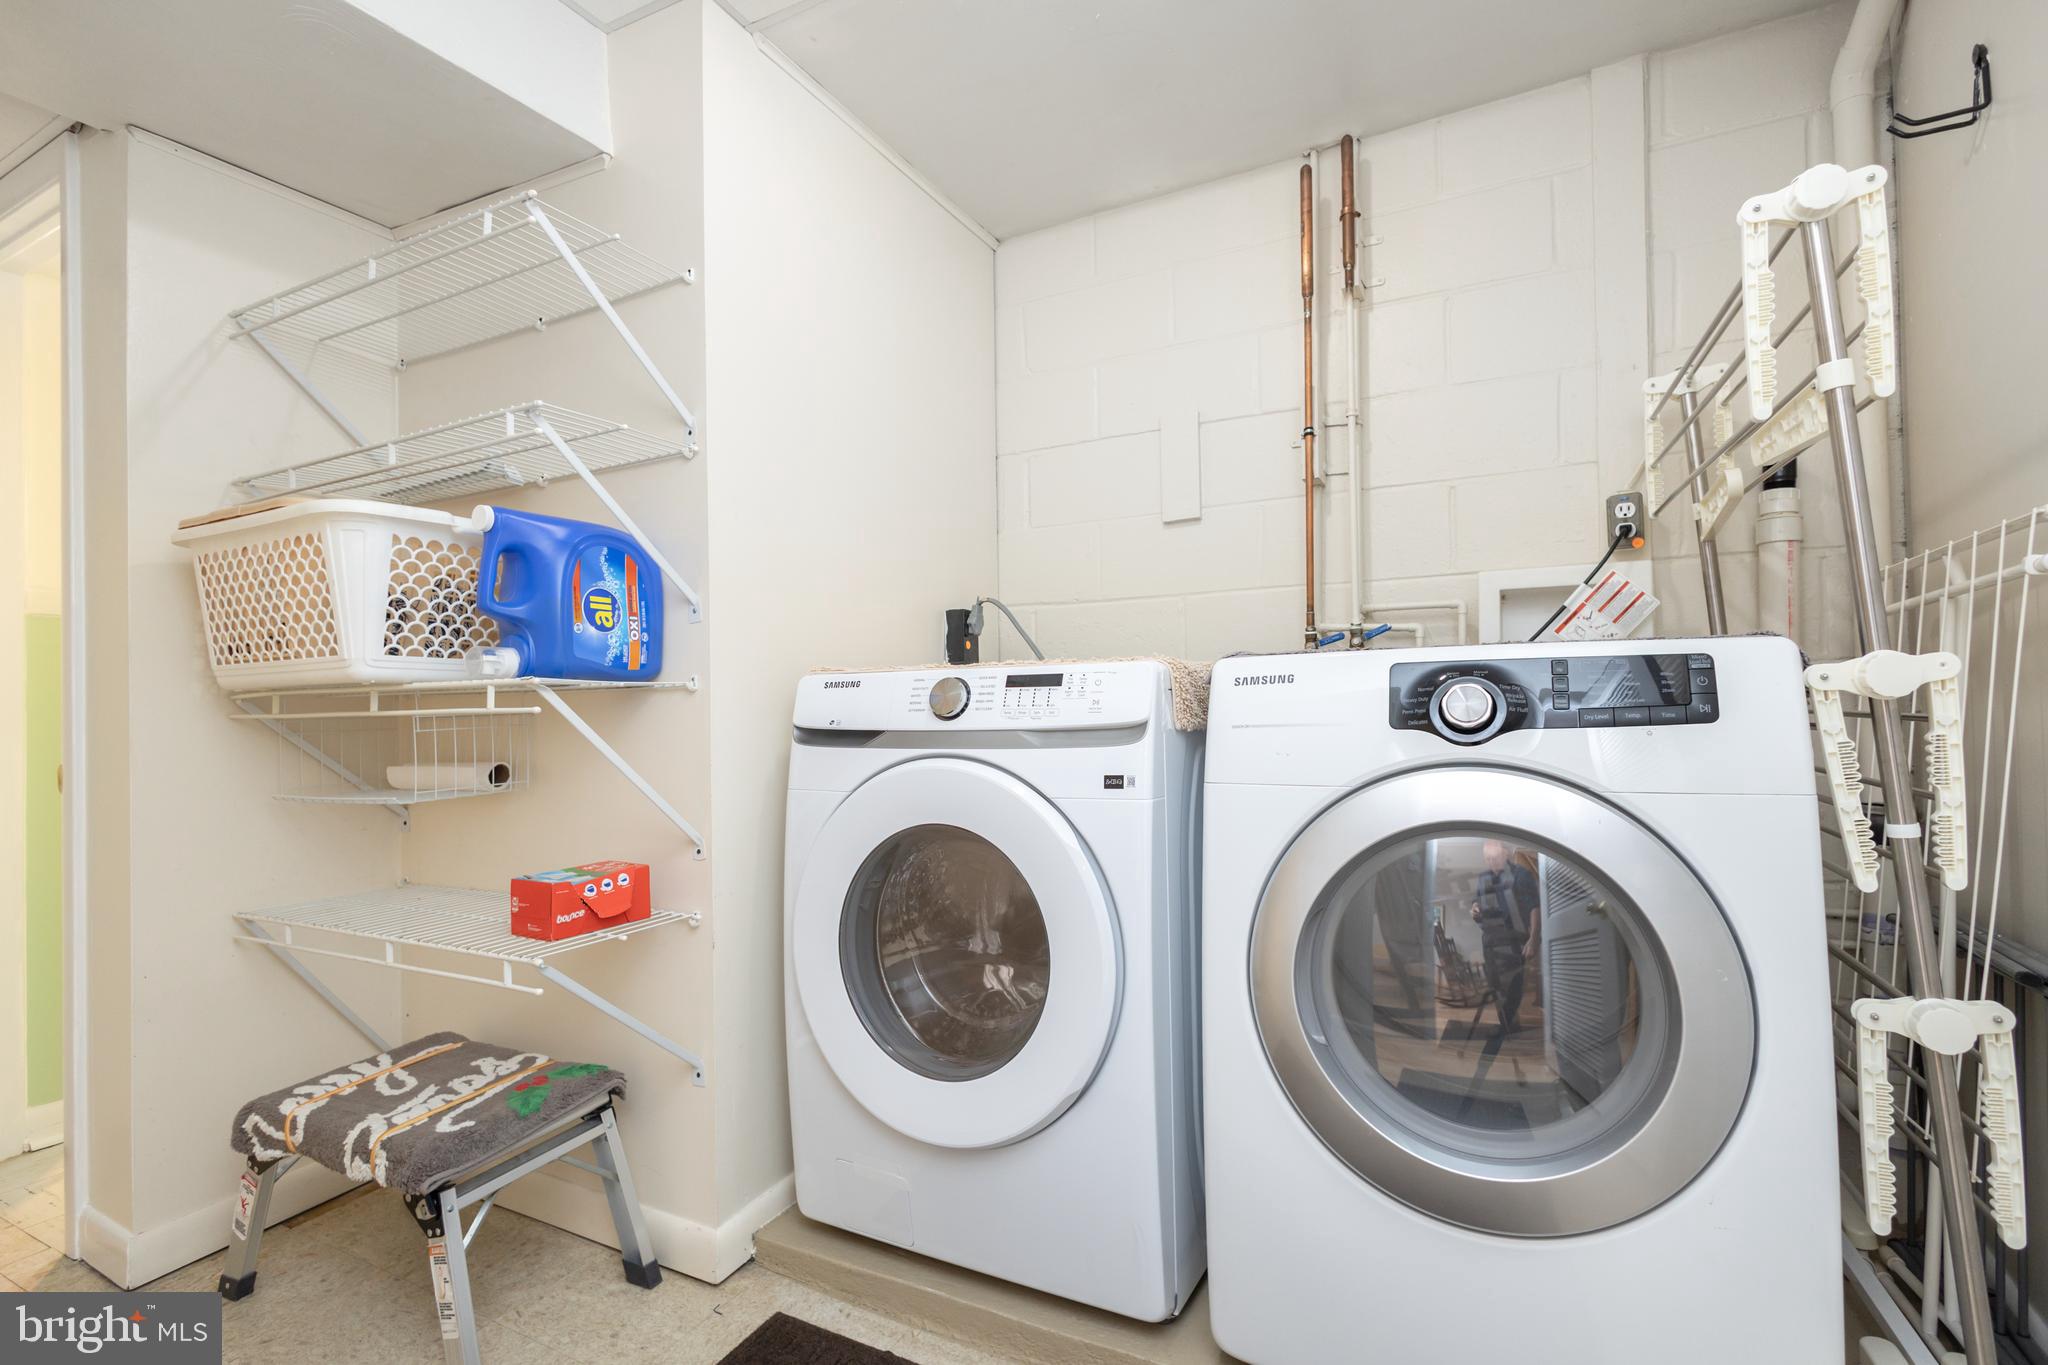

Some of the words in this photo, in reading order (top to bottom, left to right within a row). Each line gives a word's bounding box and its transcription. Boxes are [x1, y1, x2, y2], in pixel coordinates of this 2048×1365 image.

[590, 595, 615, 628] all
[629, 616, 640, 641] OXI
[823, 680, 861, 690] SAMSUNG
[1234, 674, 1295, 687] SAMSUNG
[556, 909, 585, 924] bounce
